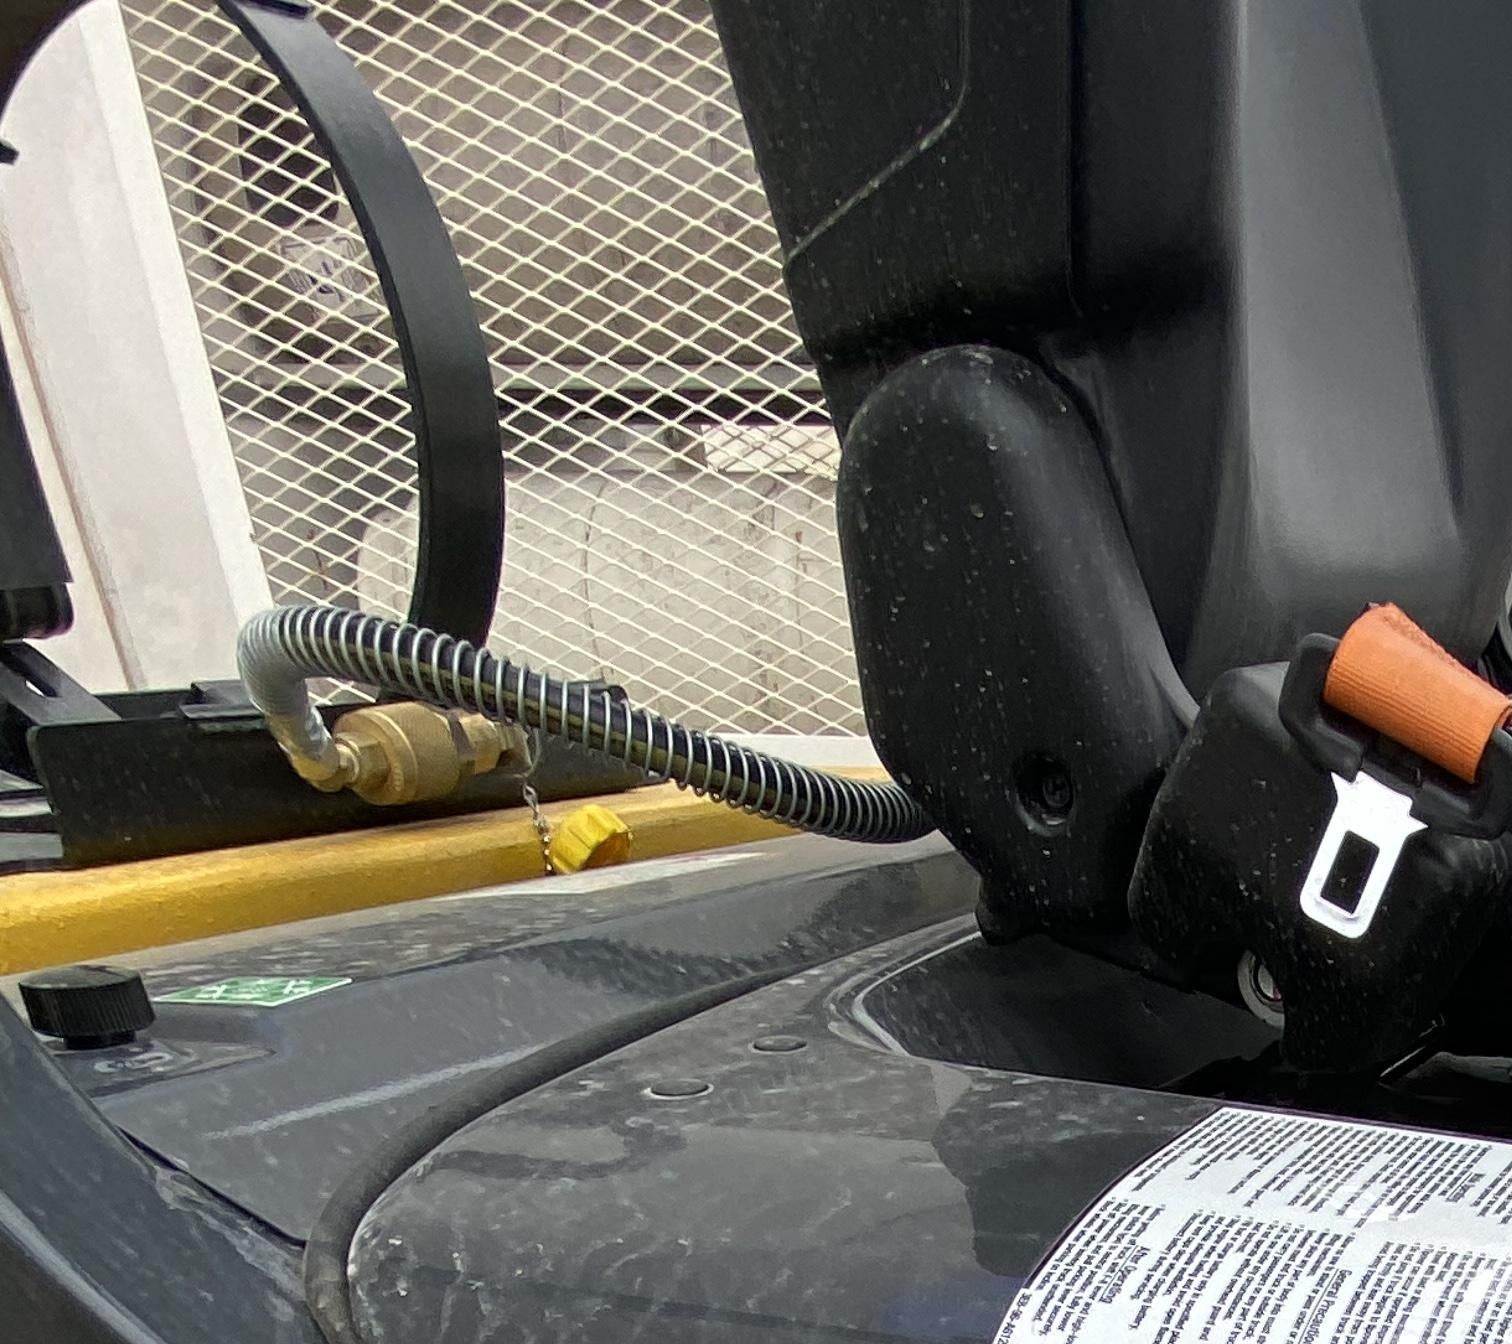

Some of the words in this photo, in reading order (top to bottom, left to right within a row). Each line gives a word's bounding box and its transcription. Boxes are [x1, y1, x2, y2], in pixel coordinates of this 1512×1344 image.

[1127, 1245, 1153, 1266] After
[1096, 1264, 1139, 1305] Operating
[1324, 1268, 1354, 1300] General
